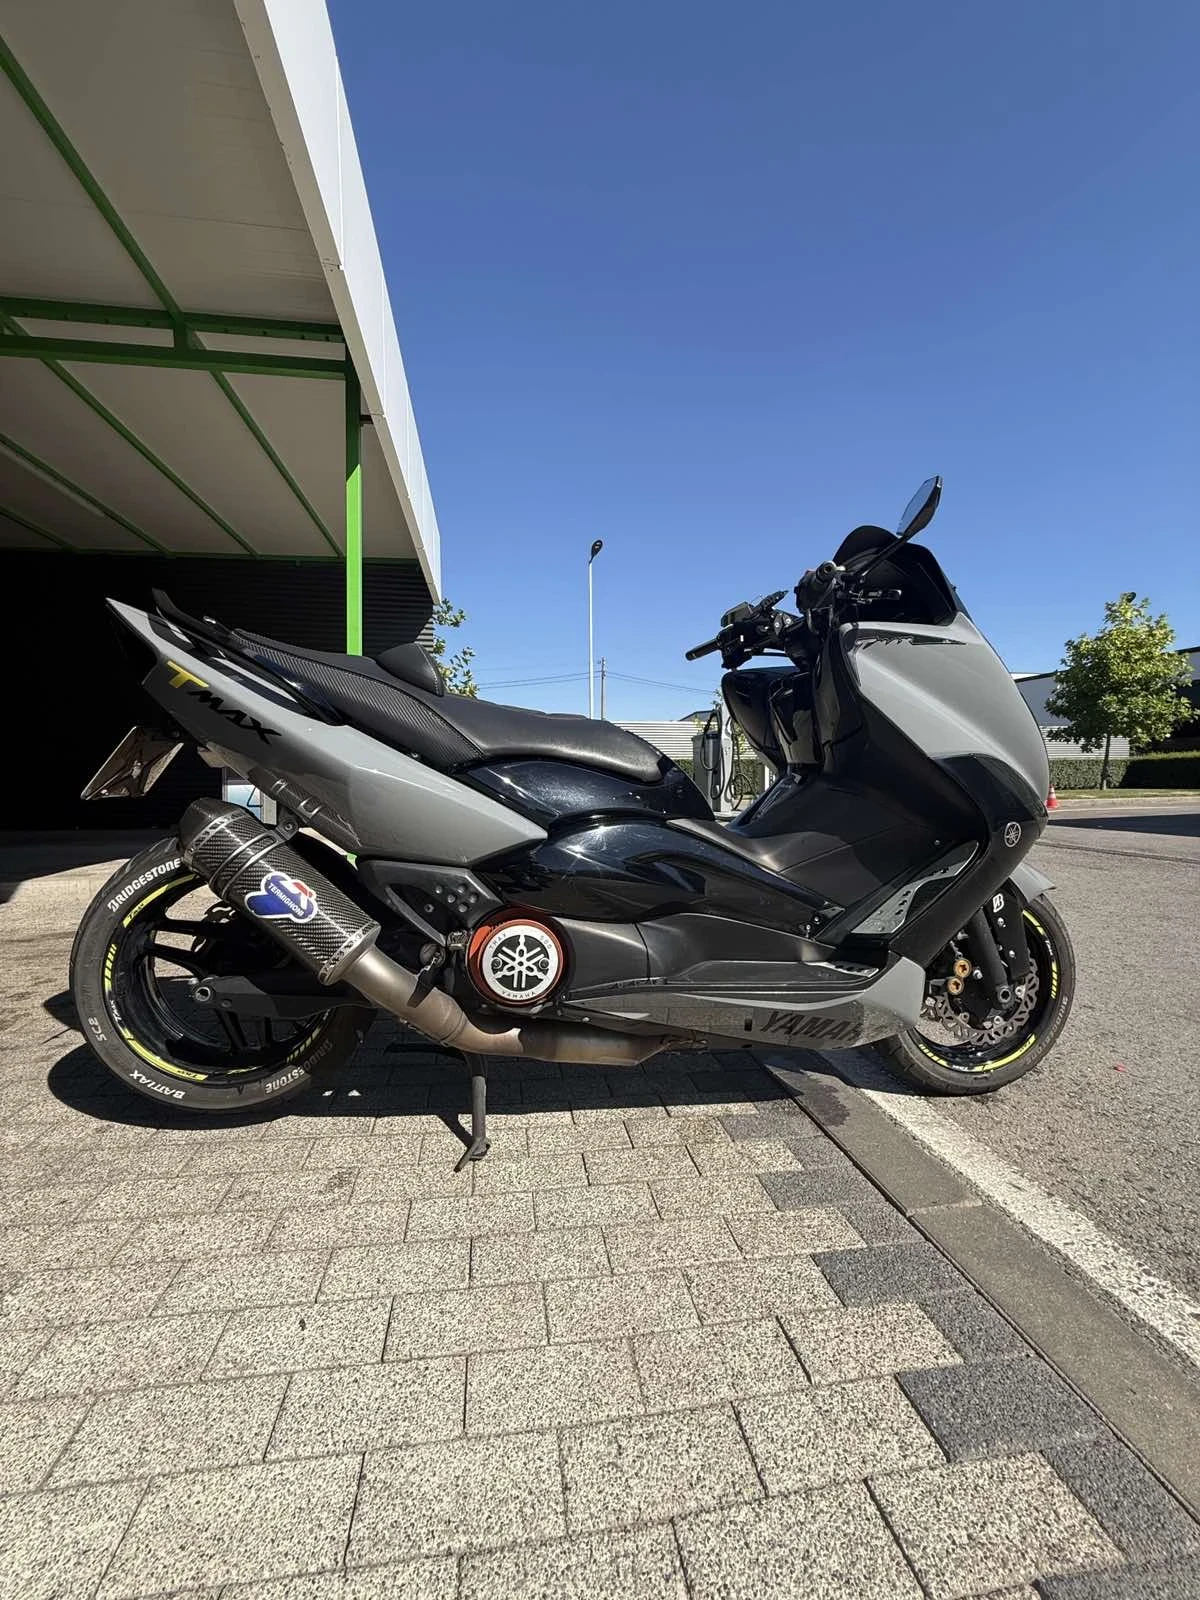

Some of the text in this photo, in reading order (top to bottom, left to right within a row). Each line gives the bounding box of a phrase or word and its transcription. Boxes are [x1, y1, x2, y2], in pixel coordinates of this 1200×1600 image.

[107, 857, 182, 913] BRIDGESTONE
[267, 882, 305, 917] TERMIGNONI
[501, 989, 537, 999] YAMAHA
[760, 1011, 868, 1042] YAMAH
[129, 1069, 186, 1100] BATTLAX
